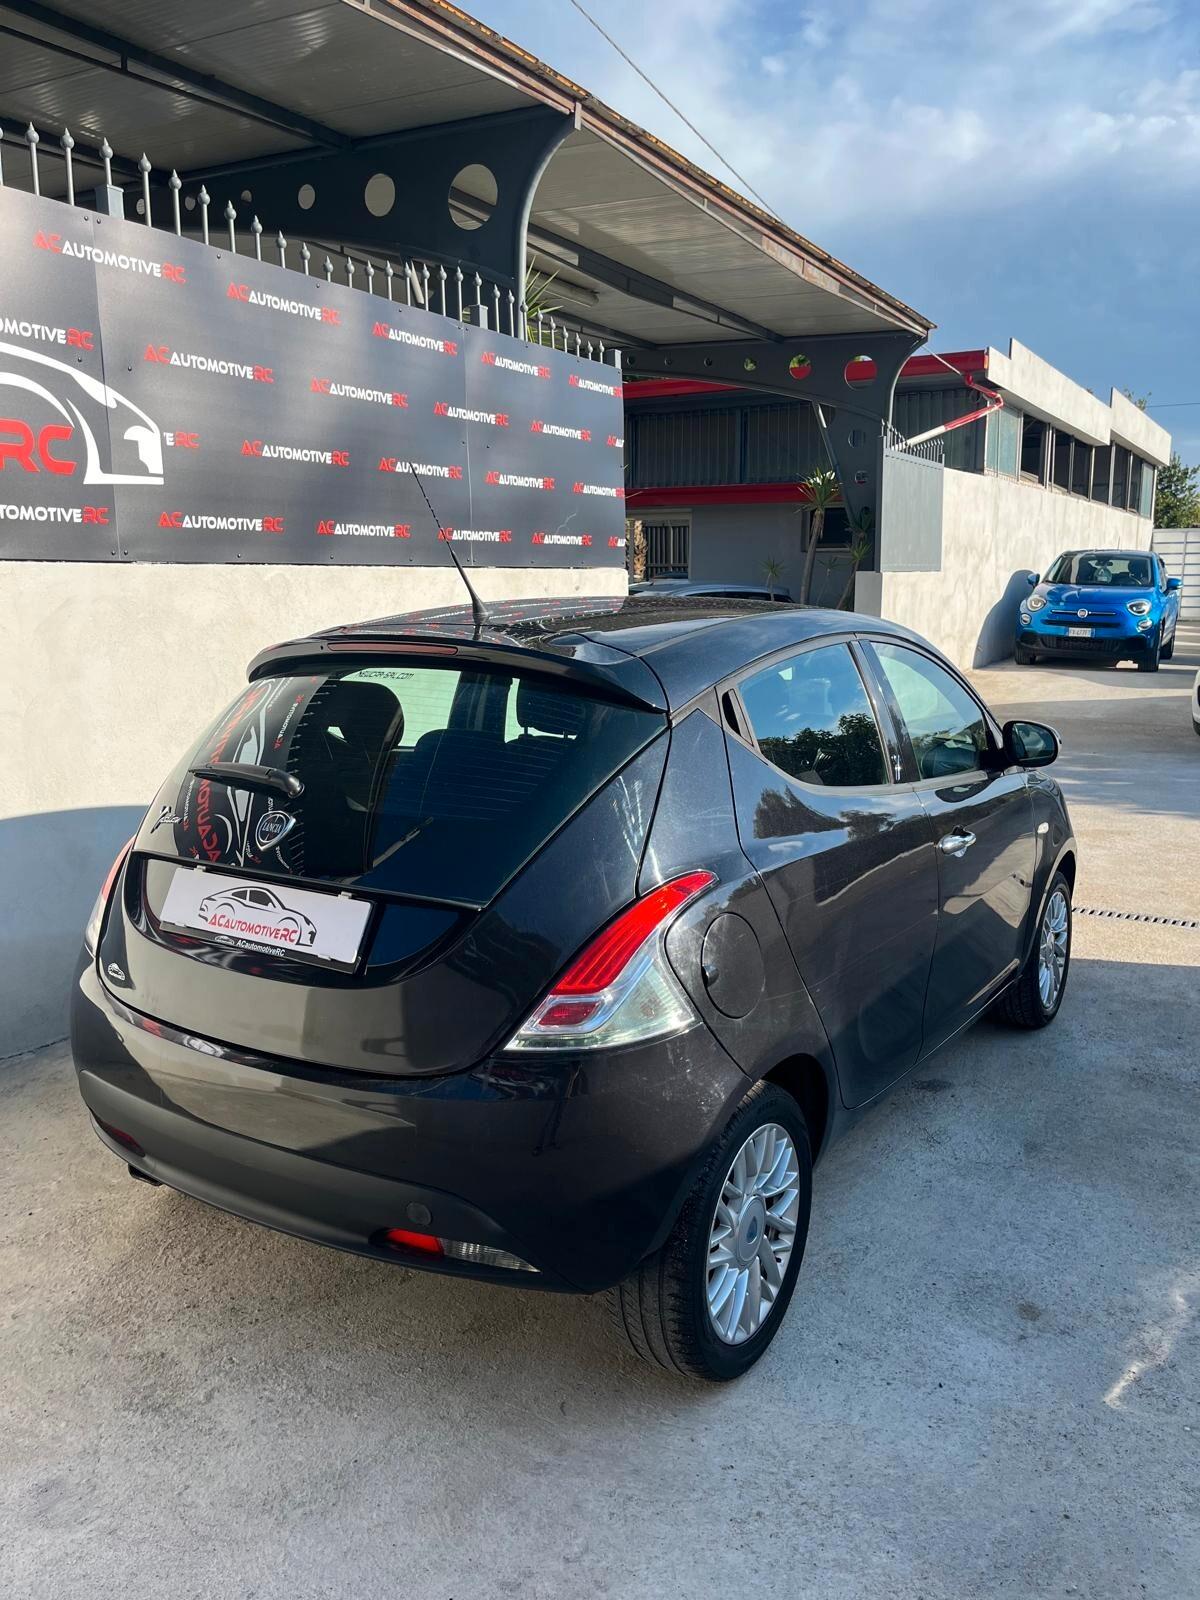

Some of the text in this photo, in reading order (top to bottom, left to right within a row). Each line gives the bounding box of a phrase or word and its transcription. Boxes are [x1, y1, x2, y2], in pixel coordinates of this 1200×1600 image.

[33, 231, 186, 283] ACAUTOMOTIVERC
[227, 282, 341, 325] ACAUTOMOTIVERC
[372, 322, 458, 356] ACAUTOMOTIVERC
[144, 344, 275, 384] ACAUTOMOTIVERC
[480, 352, 551, 379] ACAUTOMOTIVERC
[310, 377, 409, 408] ACAUTOMOTIVERC
[433, 402, 509, 427] ACAUTOMOTIVERC
[530, 420, 592, 442] ACAUTOMOTIVERC
[241, 440, 350, 467] ACAUTOMOTIVERC
[378, 457, 463, 480] ACAUTOMOTIVERC
[485, 471, 555, 490] ACAUTOMOTIVERC
[158, 511, 284, 533] ACAUTOMOTIVERC
[316, 520, 411, 539] ACAUTOMOTIVERC
[438, 527, 512, 543] ACAUTOMOTIVERC
[531, 532, 592, 547] ACAUTOMOTIVERC
[208, 913, 298, 943] ACAUTOMOTIVERC
